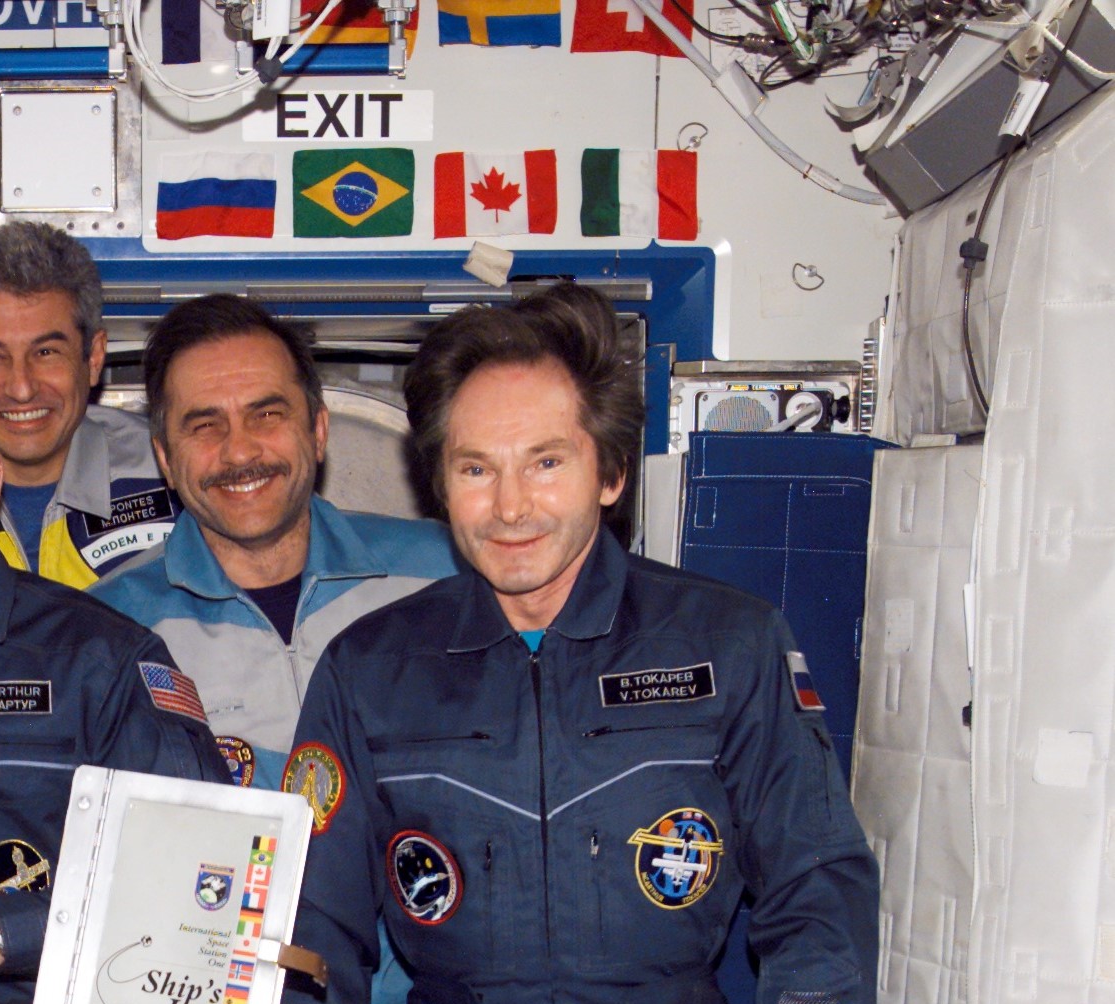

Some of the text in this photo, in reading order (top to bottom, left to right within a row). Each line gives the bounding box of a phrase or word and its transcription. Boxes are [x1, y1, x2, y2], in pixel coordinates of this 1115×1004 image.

[276, 93, 404, 138] EXIT
[91, 533, 139, 560] ORDEM
[147, 532, 155, 542] E
[620, 684, 697, 702] V.TOKAREV
[235, 747, 252, 763] 13
[178, 922, 233, 939] International
[206, 937, 231, 949] Space
[198, 946, 228, 959] Station
[207, 957, 226, 969] One
